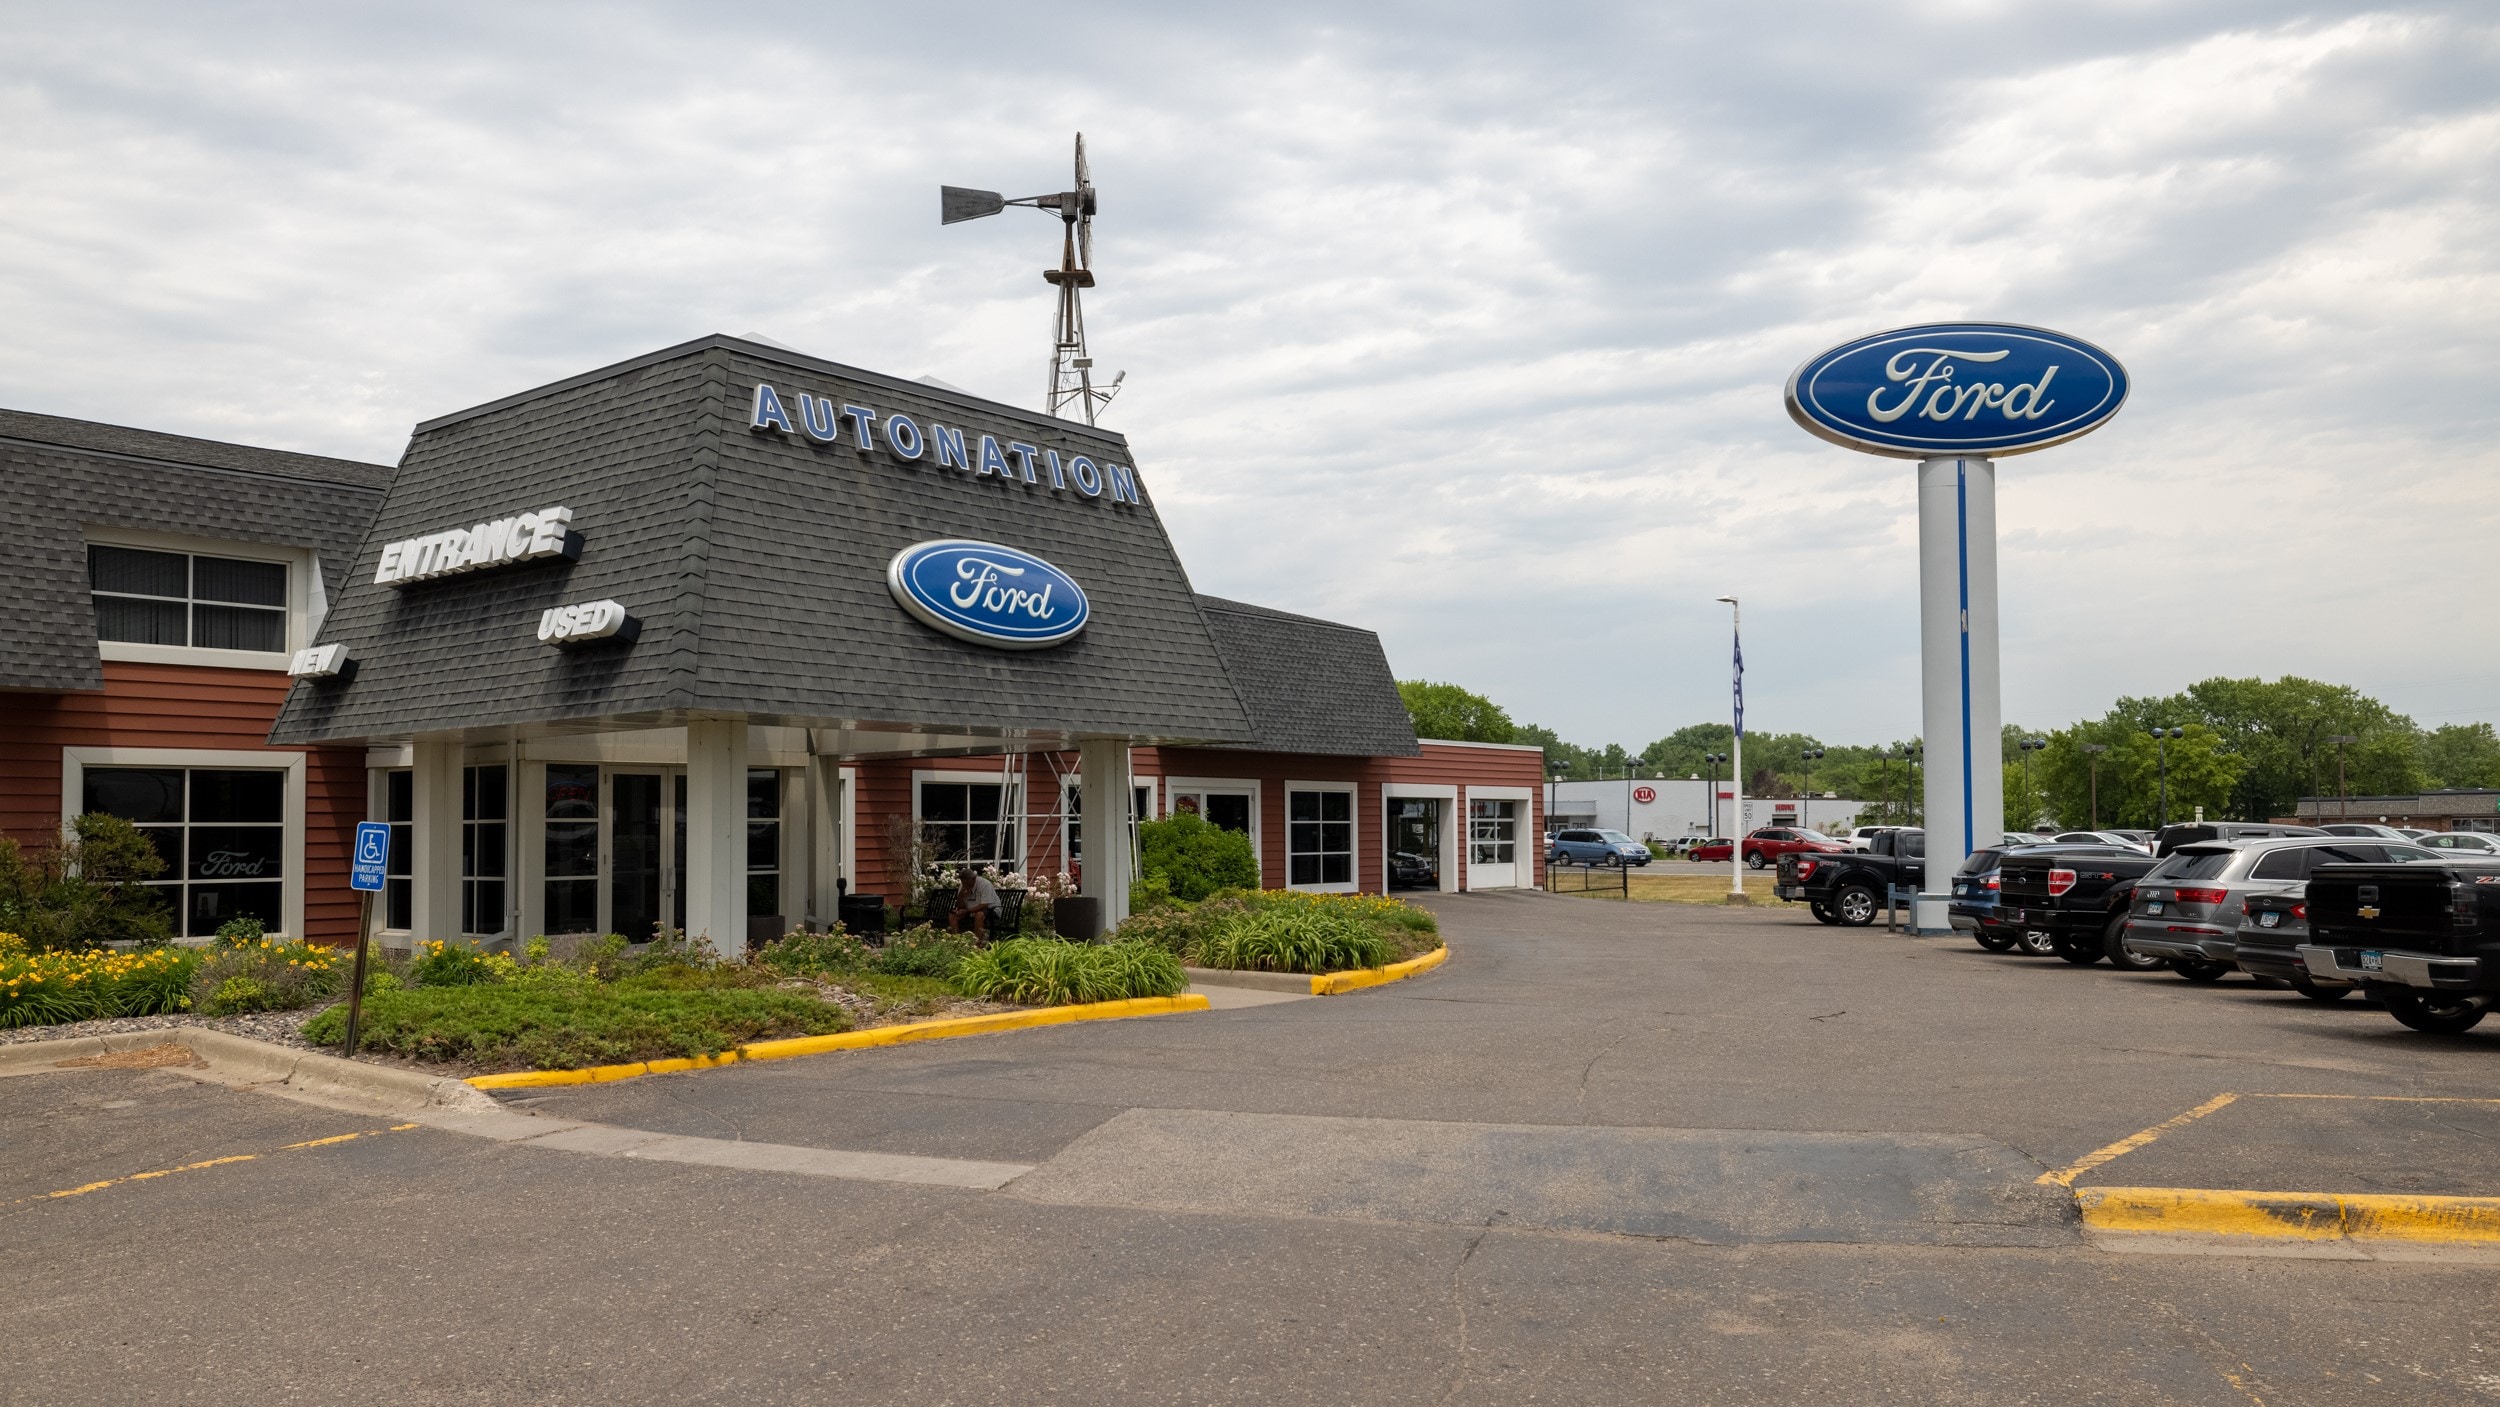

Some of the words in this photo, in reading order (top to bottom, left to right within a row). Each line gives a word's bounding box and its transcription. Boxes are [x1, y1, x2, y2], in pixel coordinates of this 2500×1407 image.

[1866, 348, 2060, 423] Ford
[749, 383, 1140, 506] AUTONATION
[374, 506, 574, 585] ENTRANCE
[950, 557, 1056, 620] Ford
[537, 599, 626, 645] USED
[287, 643, 350, 677] NEW
[1744, 812, 1752, 820] 50
[200, 850, 265, 876] Ford
[354, 864, 385, 875] HANDICAPPED
[359, 874, 379, 884] PARKING
[2079, 871, 2115, 880] STX
